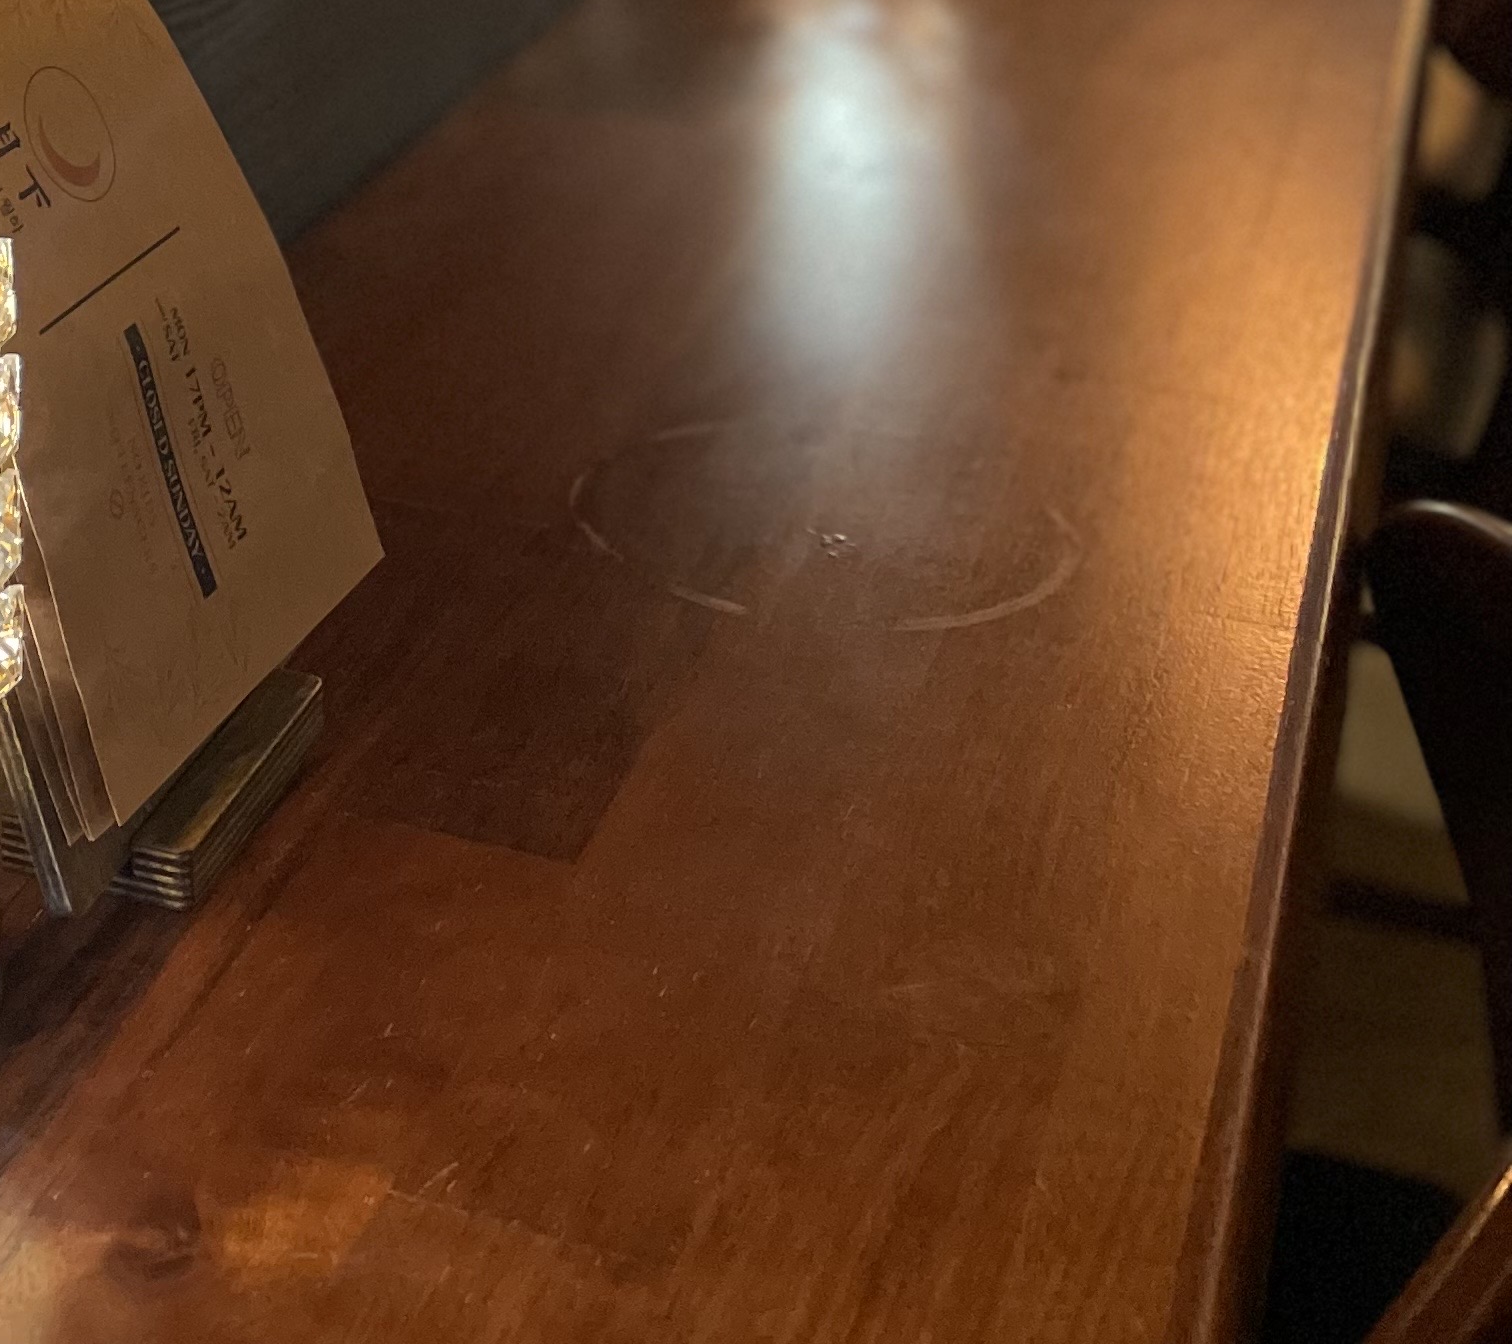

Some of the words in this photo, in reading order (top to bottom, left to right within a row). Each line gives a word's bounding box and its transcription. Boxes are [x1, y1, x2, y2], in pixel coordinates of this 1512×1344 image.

[169, 306, 190, 357] MON
[165, 458, 205, 558] SUNDAY
[215, 467, 249, 541] 12AM
